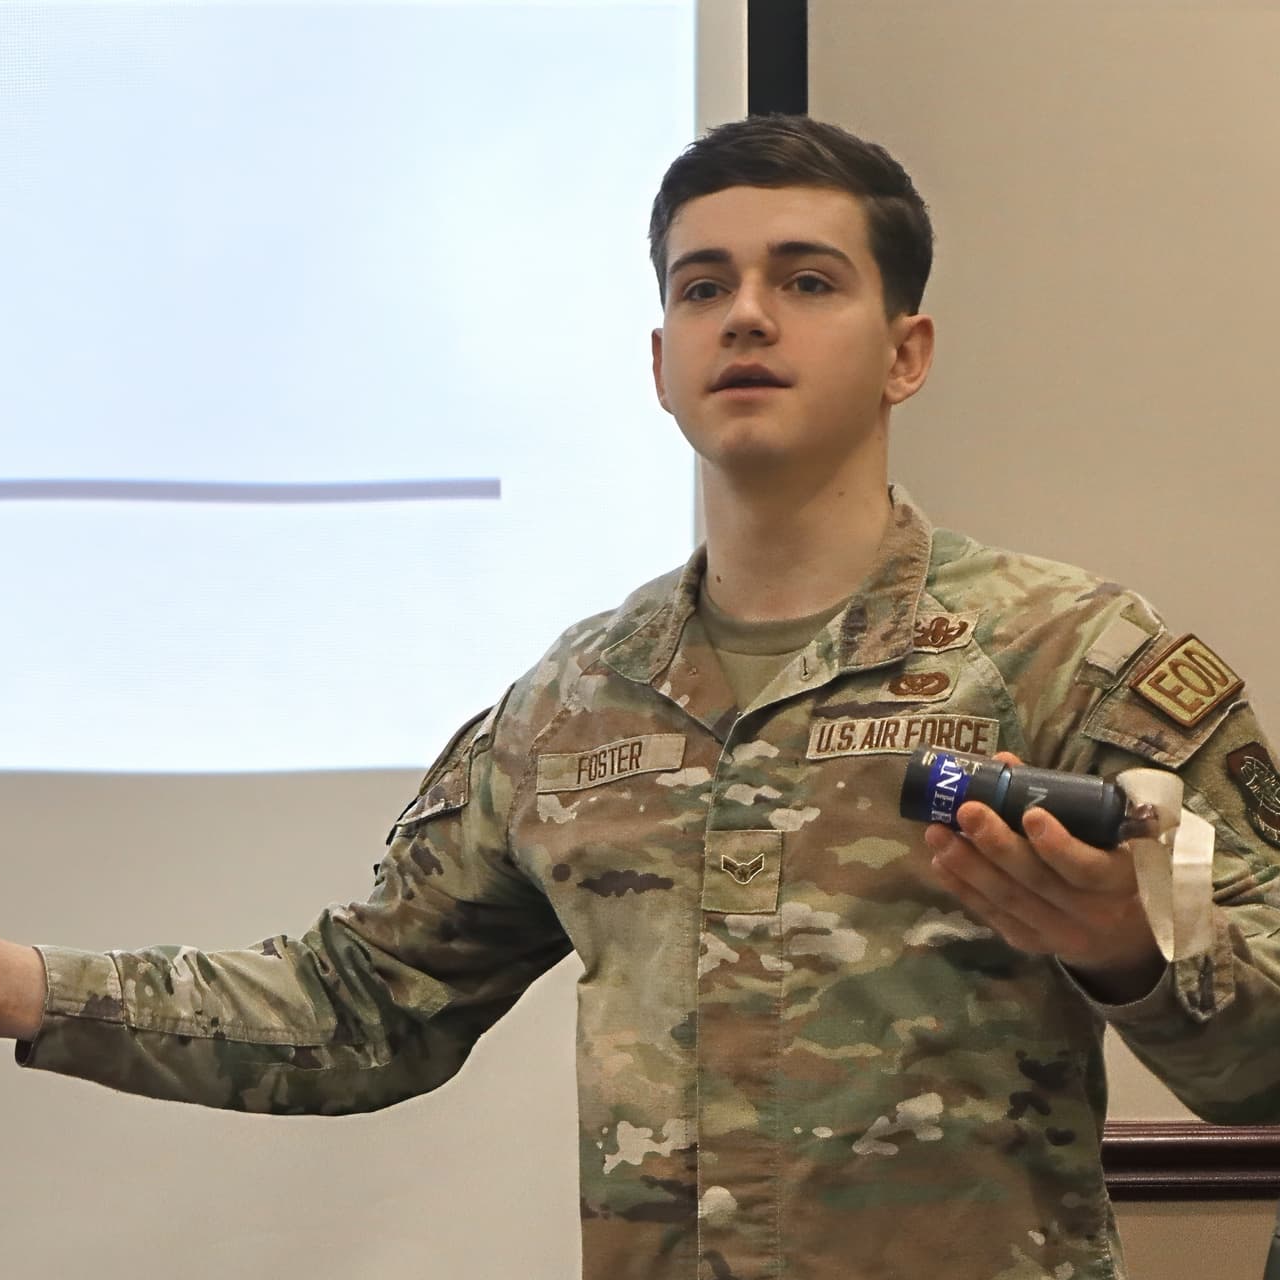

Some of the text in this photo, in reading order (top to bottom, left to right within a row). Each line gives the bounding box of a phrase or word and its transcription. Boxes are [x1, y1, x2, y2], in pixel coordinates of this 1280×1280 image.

[1147, 648, 1229, 714] EOD
[816, 717, 991, 755] U.S. AIR FORCE
[577, 740, 643, 784] FOSTER
